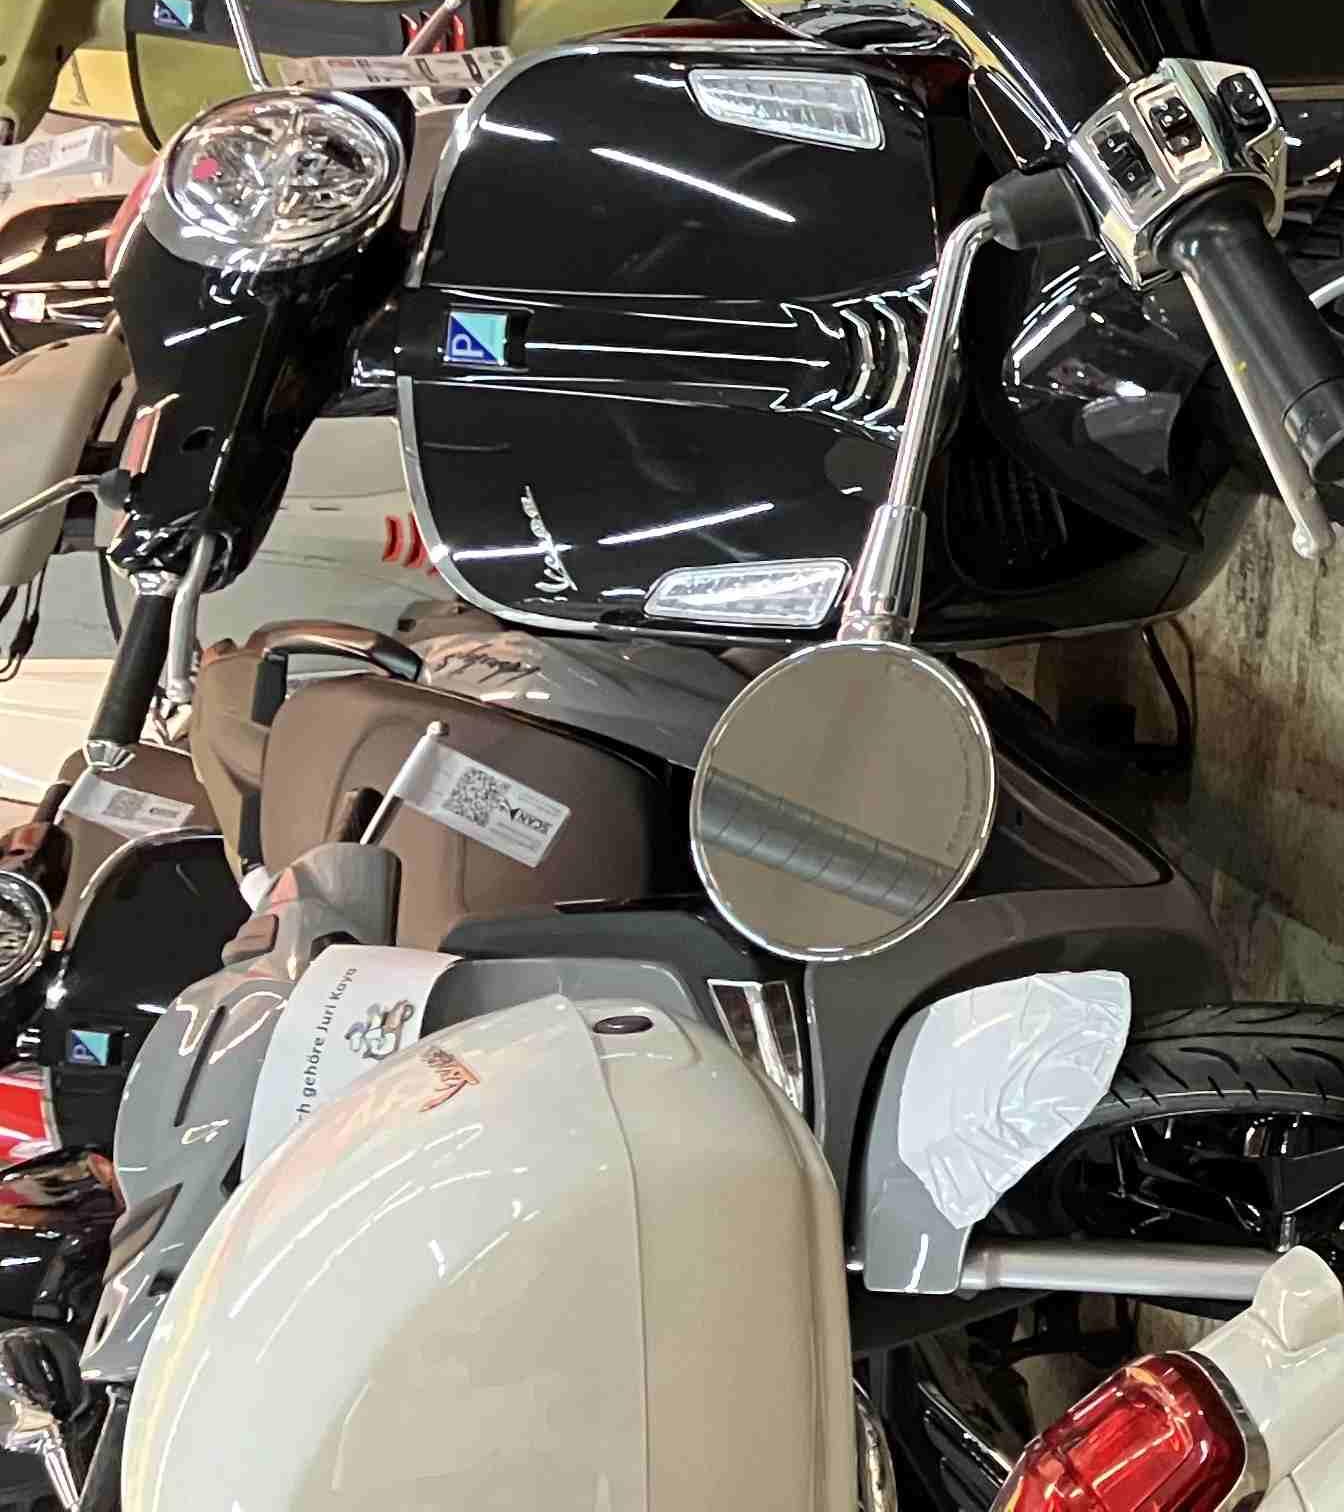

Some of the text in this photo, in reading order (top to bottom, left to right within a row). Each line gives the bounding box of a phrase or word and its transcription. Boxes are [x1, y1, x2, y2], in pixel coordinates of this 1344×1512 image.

[452, 333, 484, 357] P
[520, 485, 578, 593] Vespa
[516, 810, 553, 834] SCAN
[302, 1037, 325, 1097] gehöre
[316, 1004, 337, 1032] Juri
